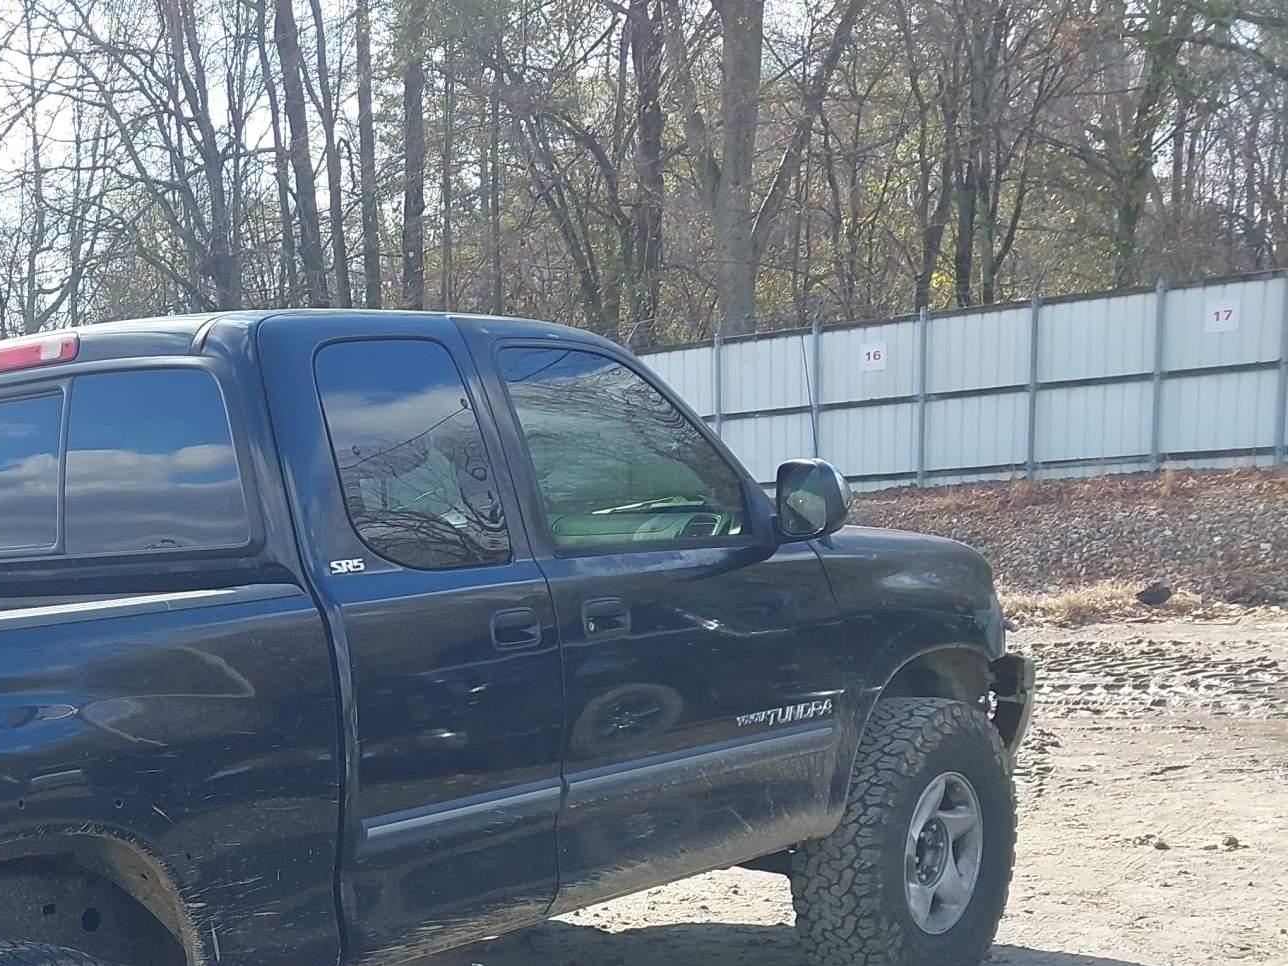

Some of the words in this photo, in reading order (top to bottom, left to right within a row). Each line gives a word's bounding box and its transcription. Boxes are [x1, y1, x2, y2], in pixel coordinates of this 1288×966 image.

[1213, 309, 1233, 322] 17
[865, 350, 881, 362] 16
[330, 557, 365, 574] SR5
[767, 698, 833, 726] TUNDRA
